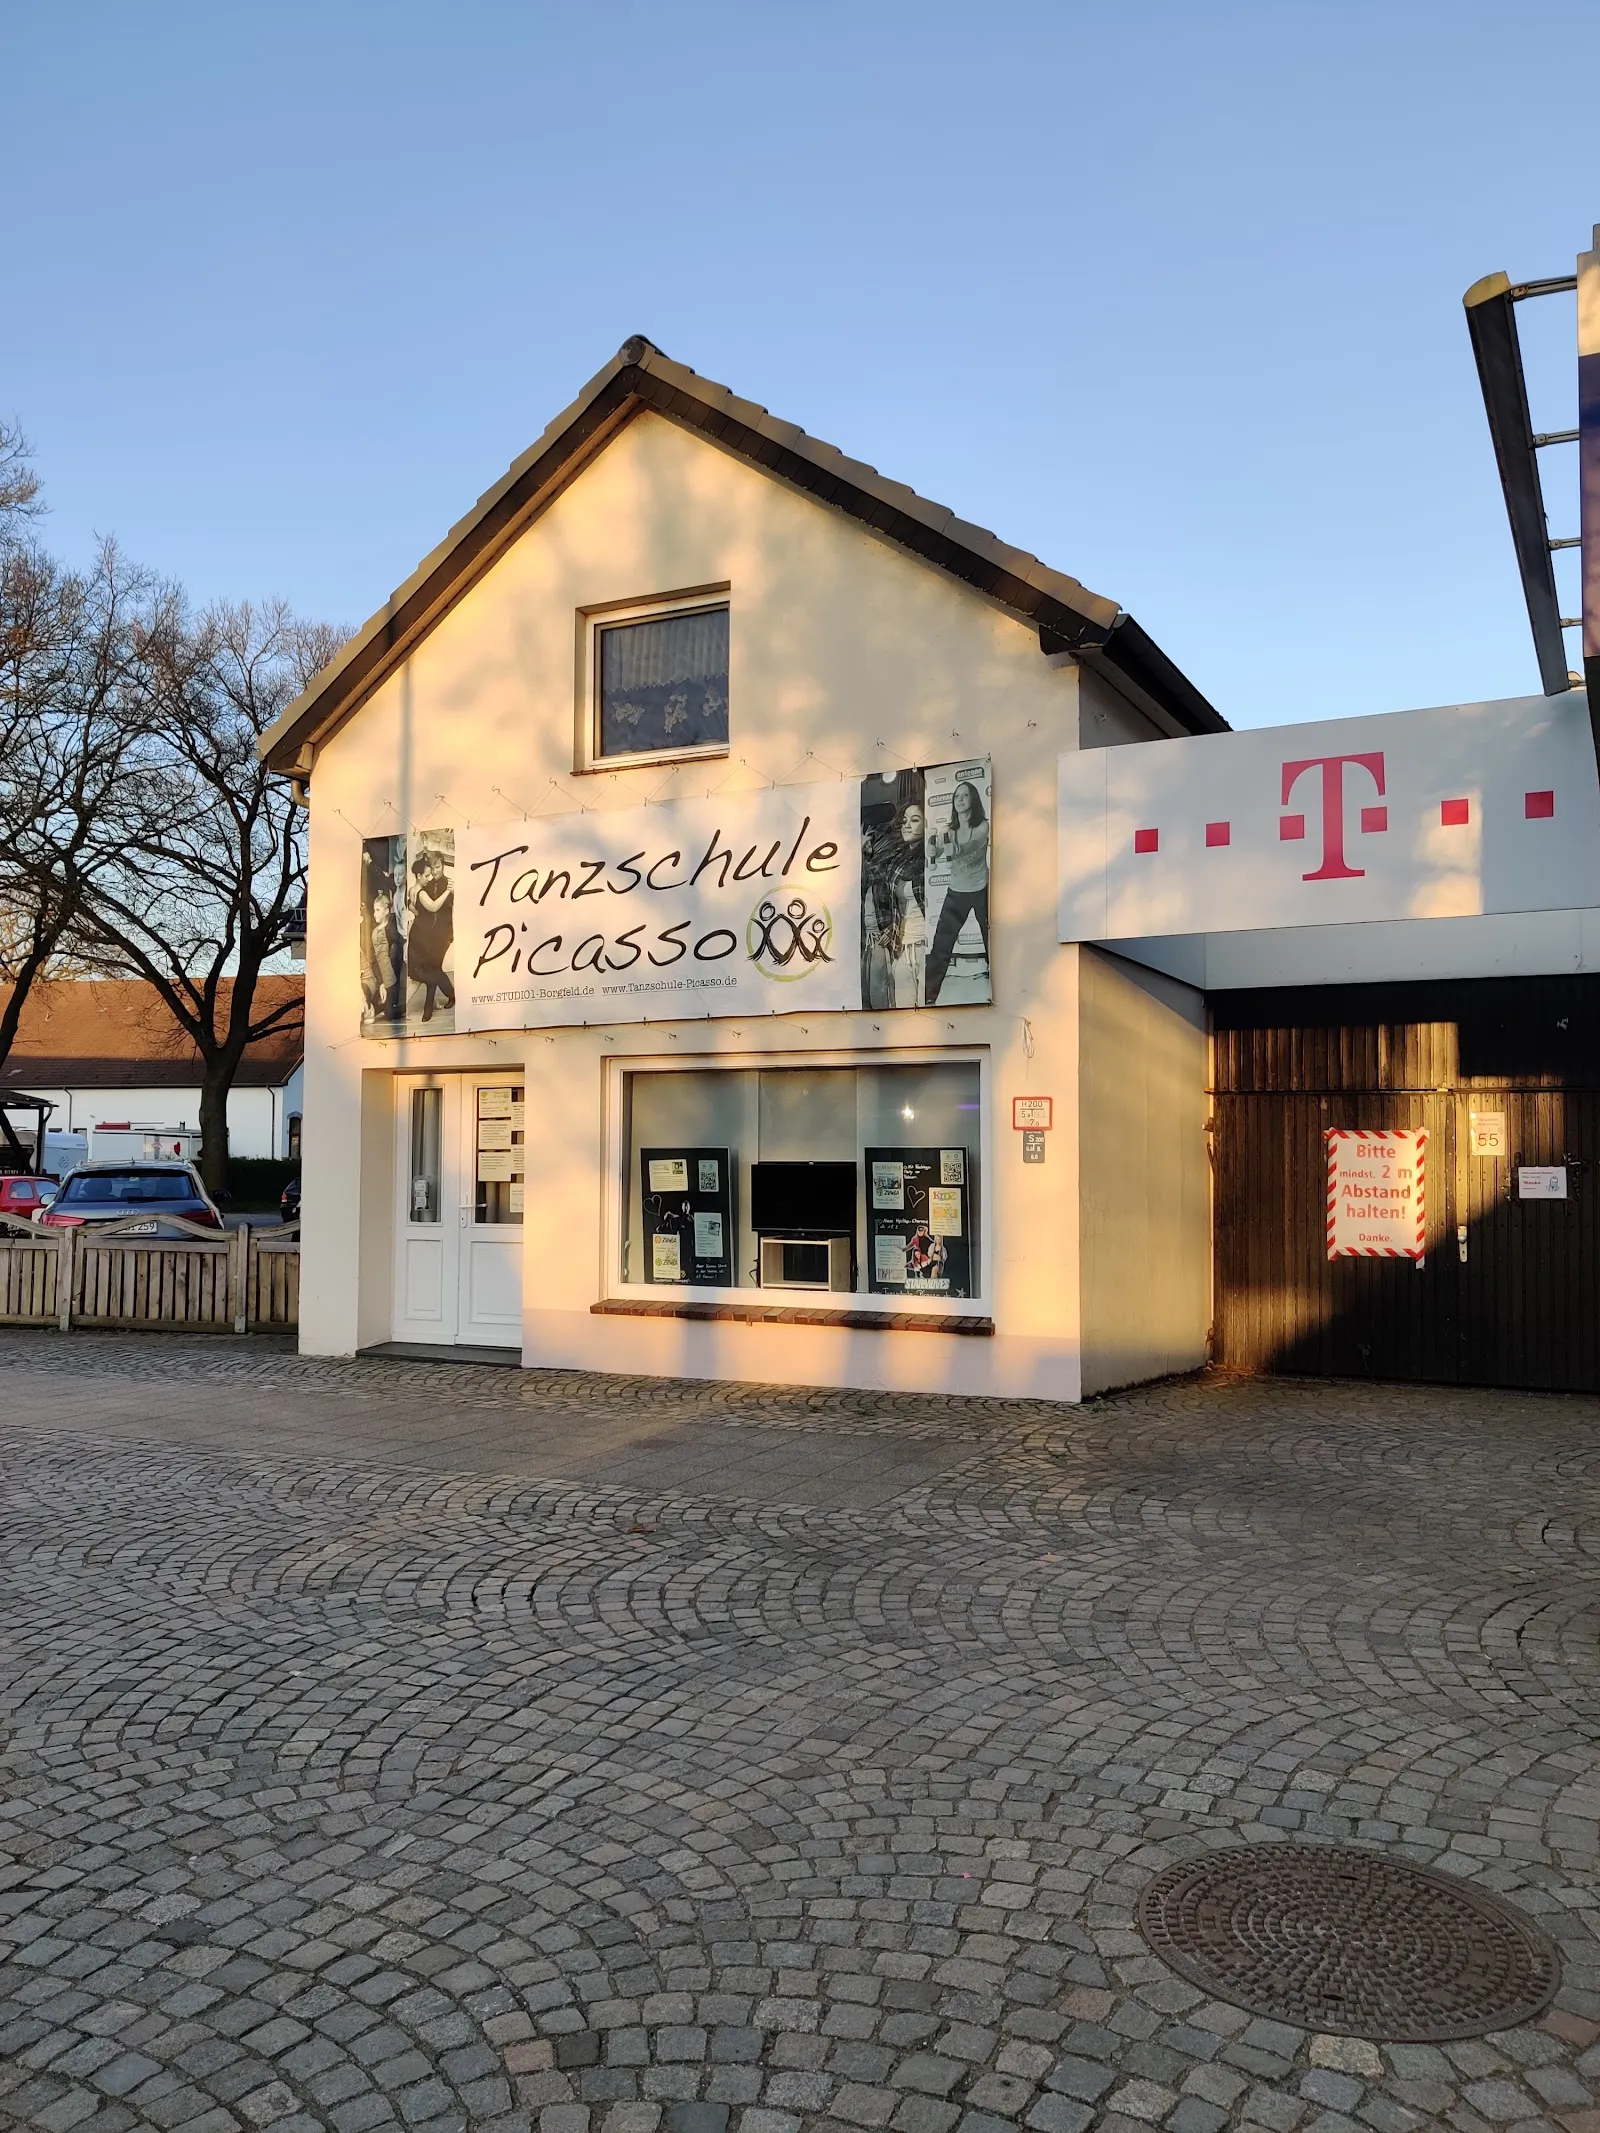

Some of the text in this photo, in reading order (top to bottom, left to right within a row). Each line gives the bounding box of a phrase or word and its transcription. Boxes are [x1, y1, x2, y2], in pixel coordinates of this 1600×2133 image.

[1282, 752, 1386, 881] T
[470, 816, 841, 907] Tanzschule
[473, 920, 738, 978] Picasso
[602, 976, 738, 995] www.Tanzschule-Picasso.de
[1478, 1133, 1499, 1147] 55
[1356, 1144, 1396, 1159] Bitte
[1339, 1165, 1413, 1179] mindst. 2 m
[1341, 1184, 1411, 1199] Abstand
[1346, 1203, 1406, 1219] halten!
[1358, 1232, 1393, 1243] Danke.
